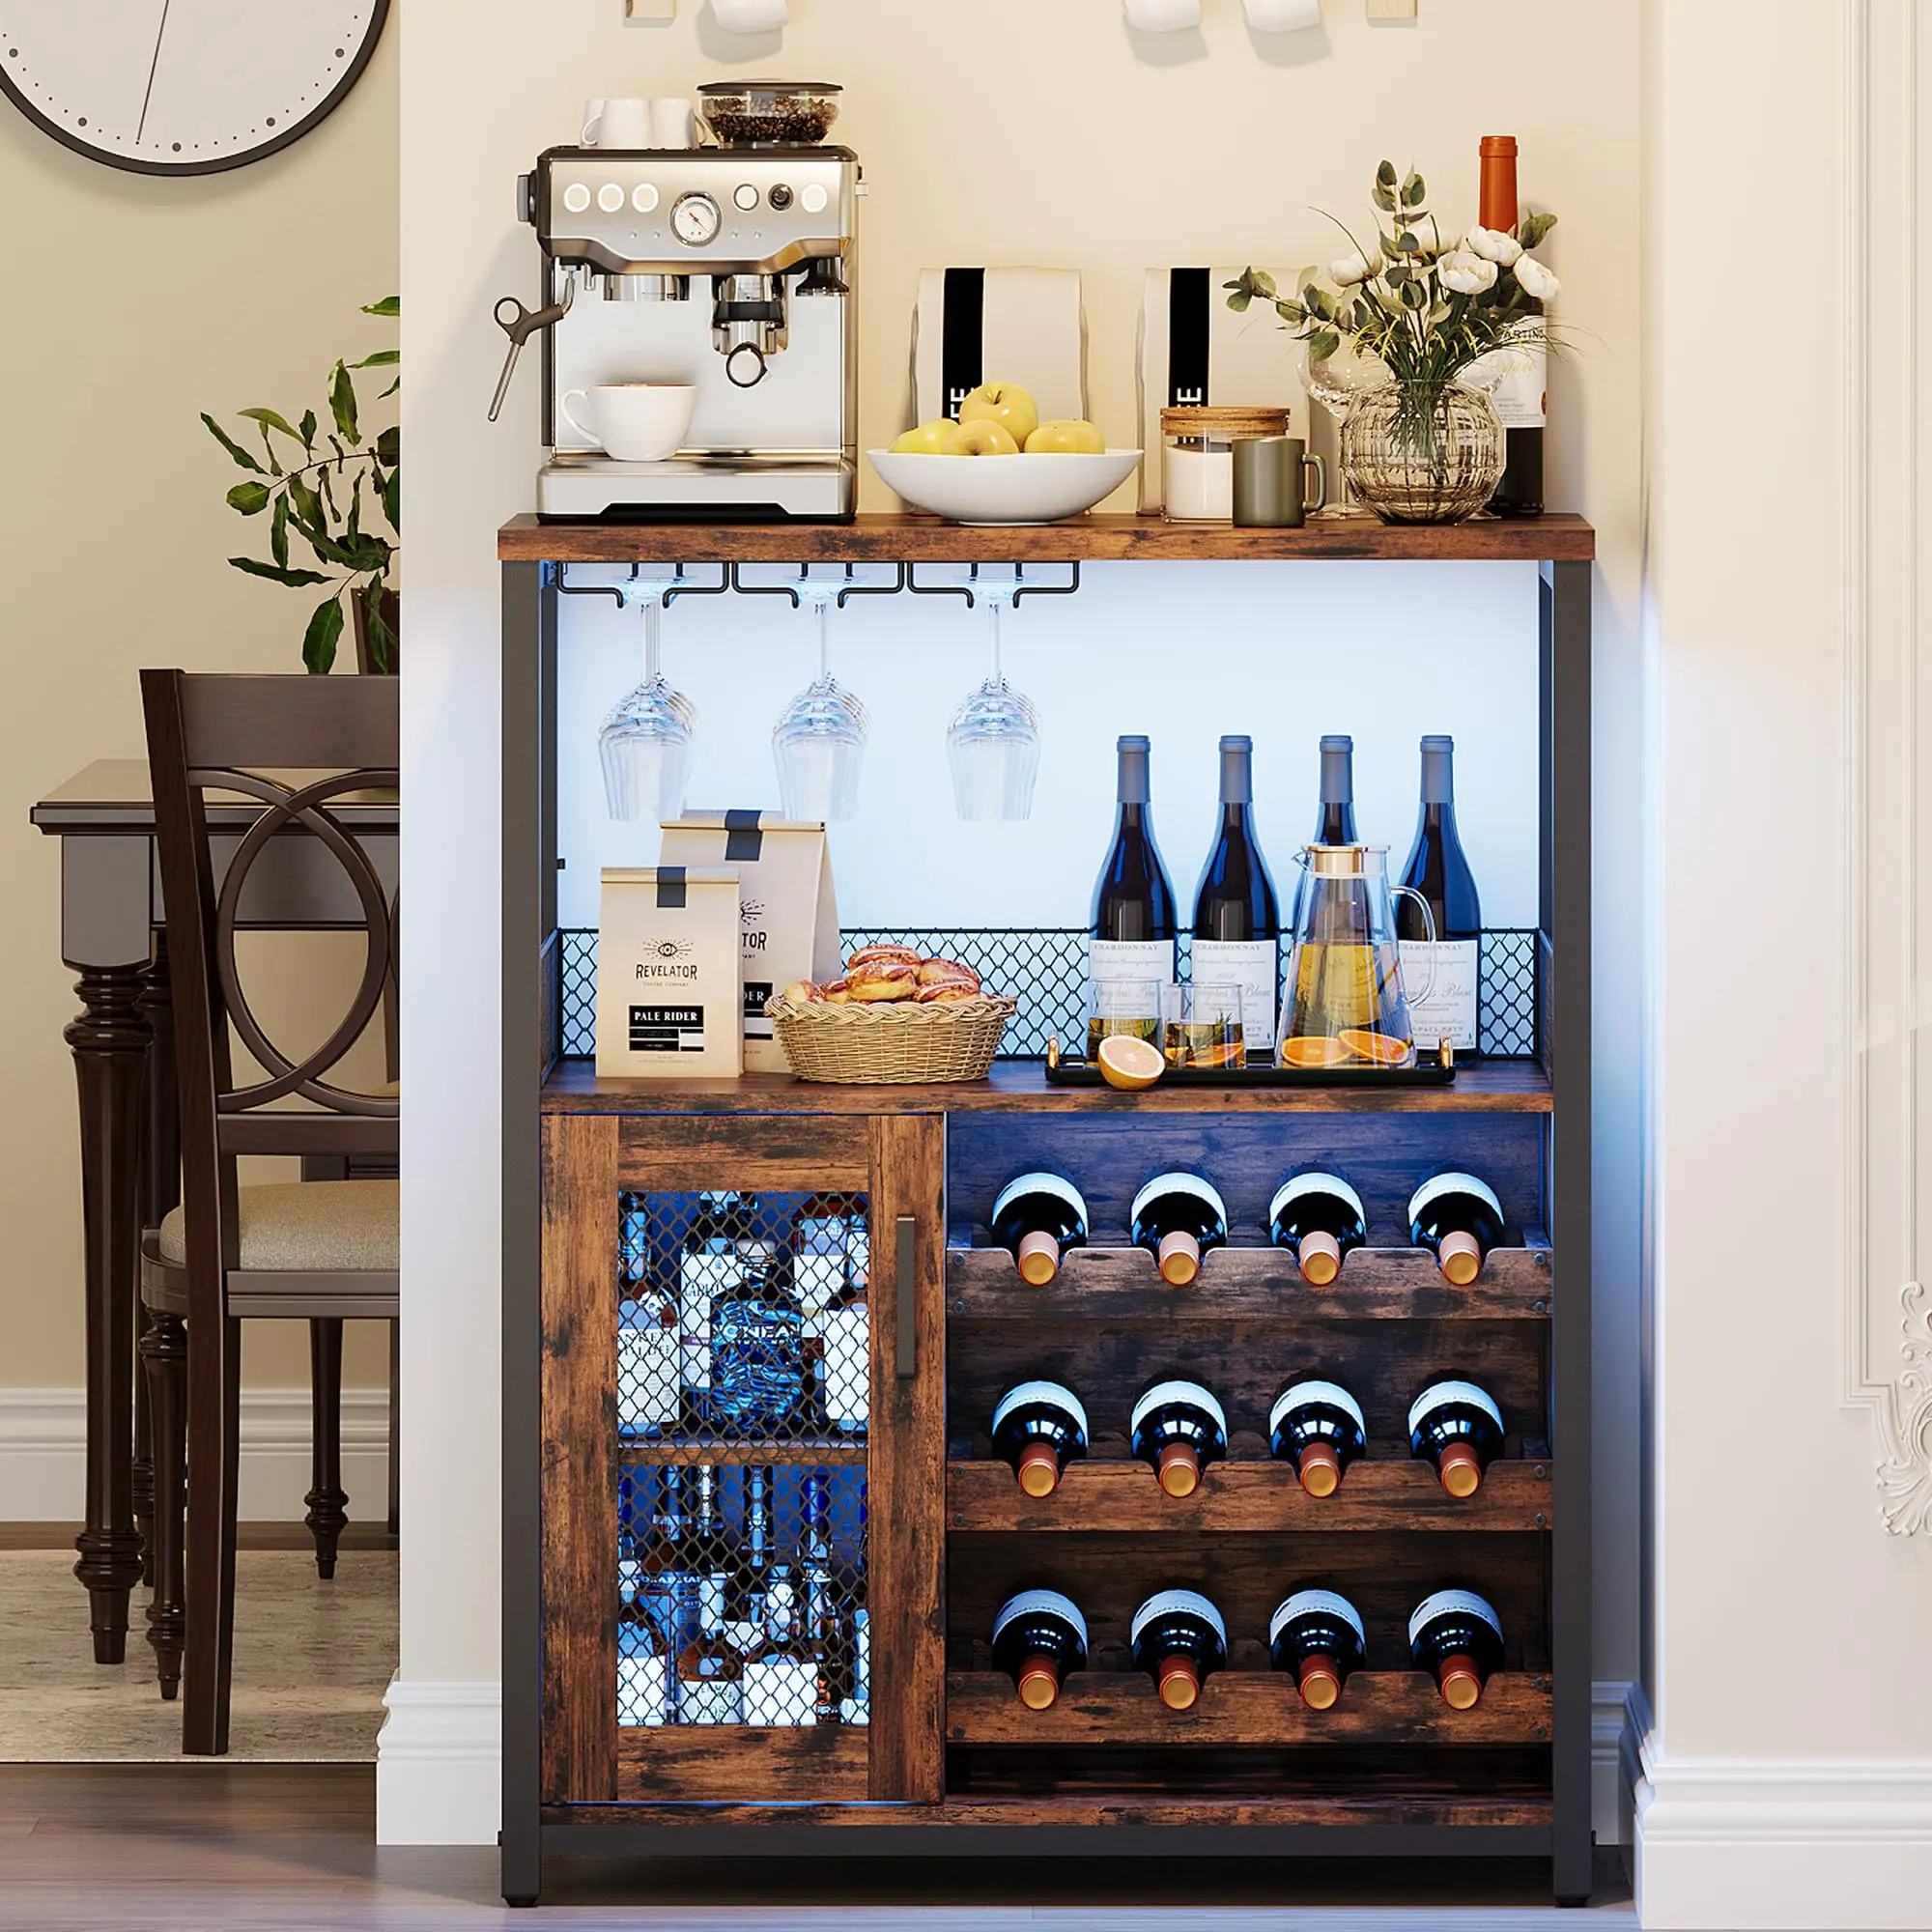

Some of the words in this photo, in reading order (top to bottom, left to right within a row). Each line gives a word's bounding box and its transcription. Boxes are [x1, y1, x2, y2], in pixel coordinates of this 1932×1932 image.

[636, 964, 697, 980] REVELATOR
[635, 1011, 661, 1021] PALE
[665, 1011, 697, 1021] RIDER
